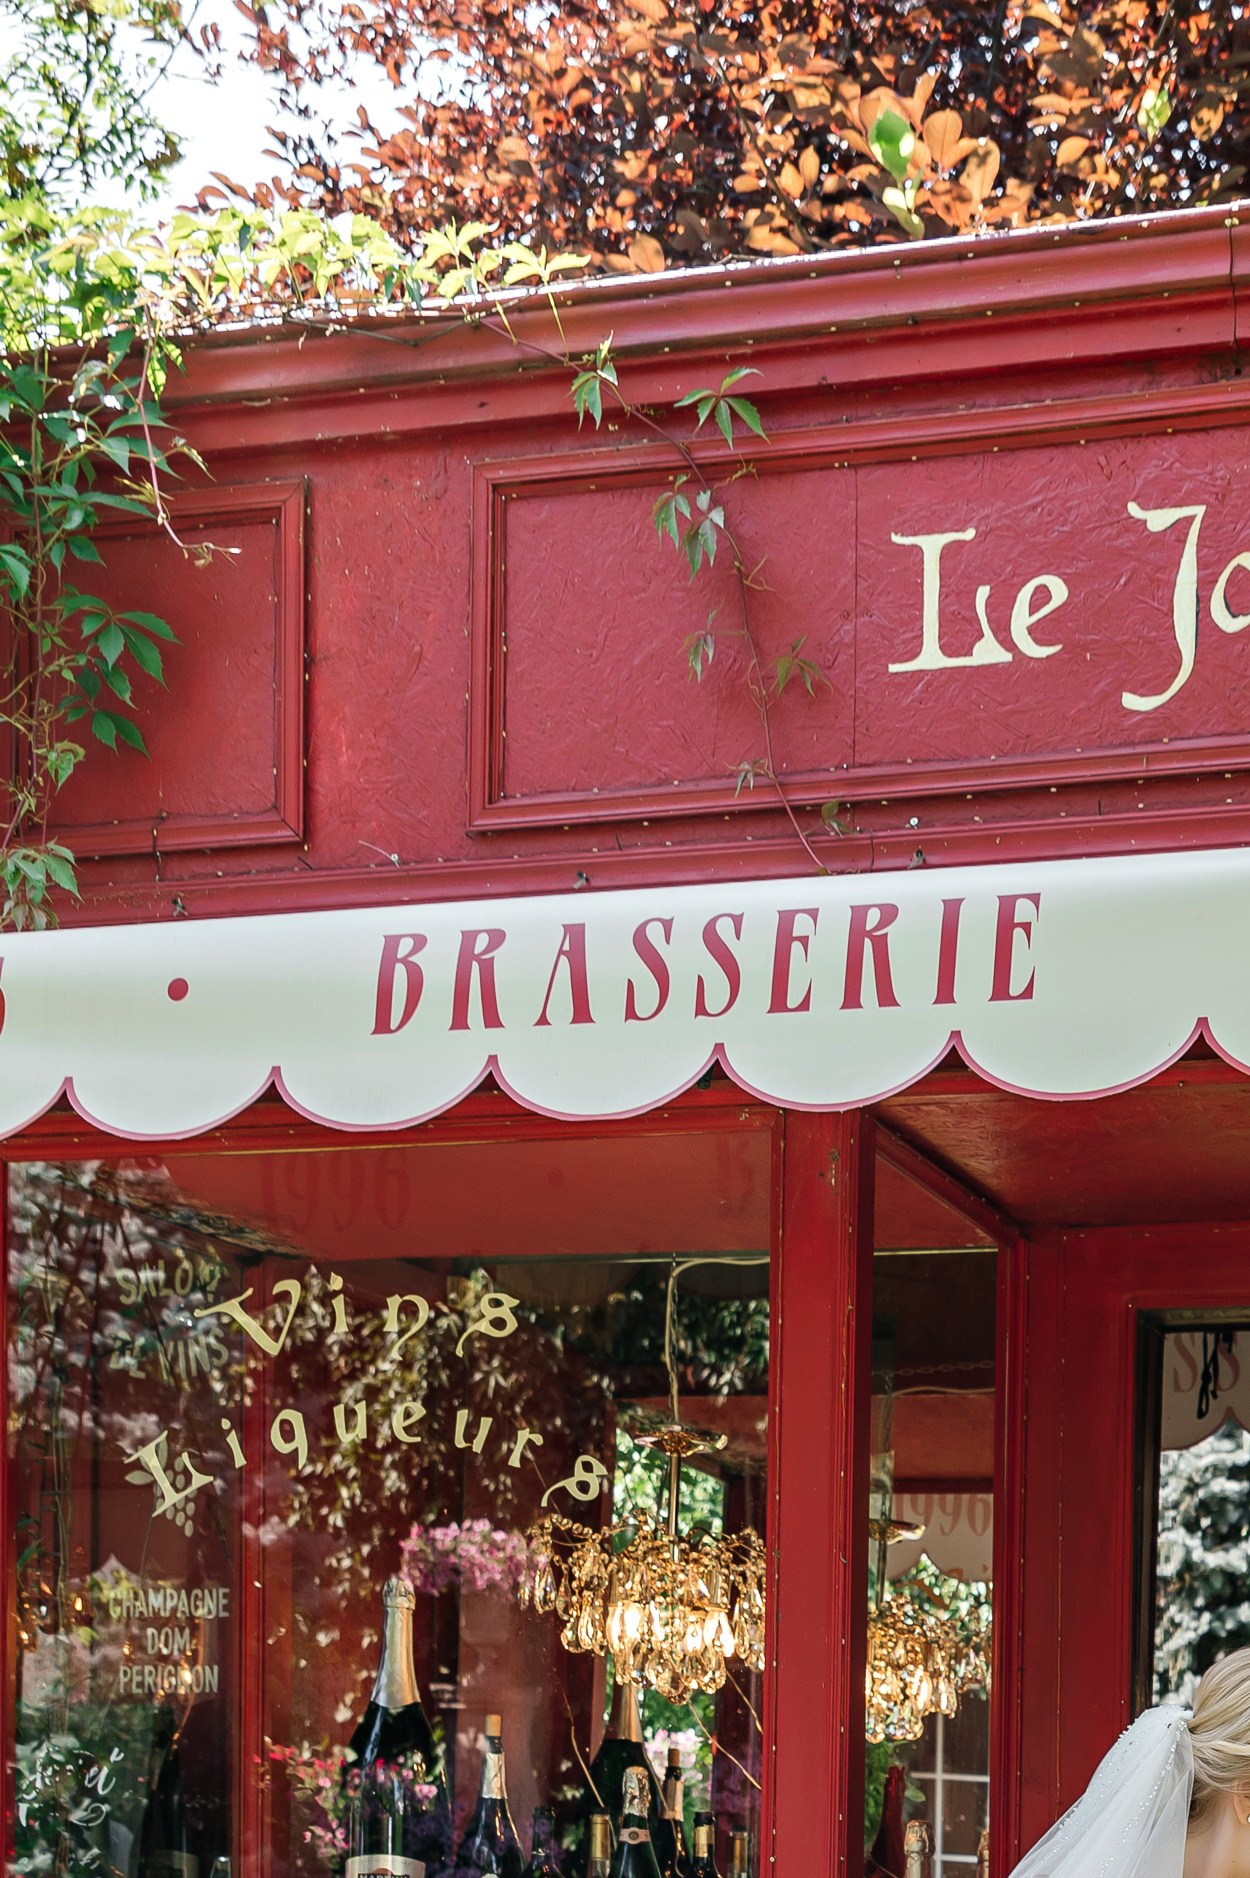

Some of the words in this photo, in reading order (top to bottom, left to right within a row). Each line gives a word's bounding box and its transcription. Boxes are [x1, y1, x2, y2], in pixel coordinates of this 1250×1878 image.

[888, 526, 1069, 673] Le
[371, 892, 1043, 1036] BRASSERIE
[195, 1271, 520, 1360] Vins
[124, 1399, 608, 1519] Liqueurs
[109, 1587, 230, 1619] CHAMPAGNE
[146, 1626, 191, 1656] DOM
